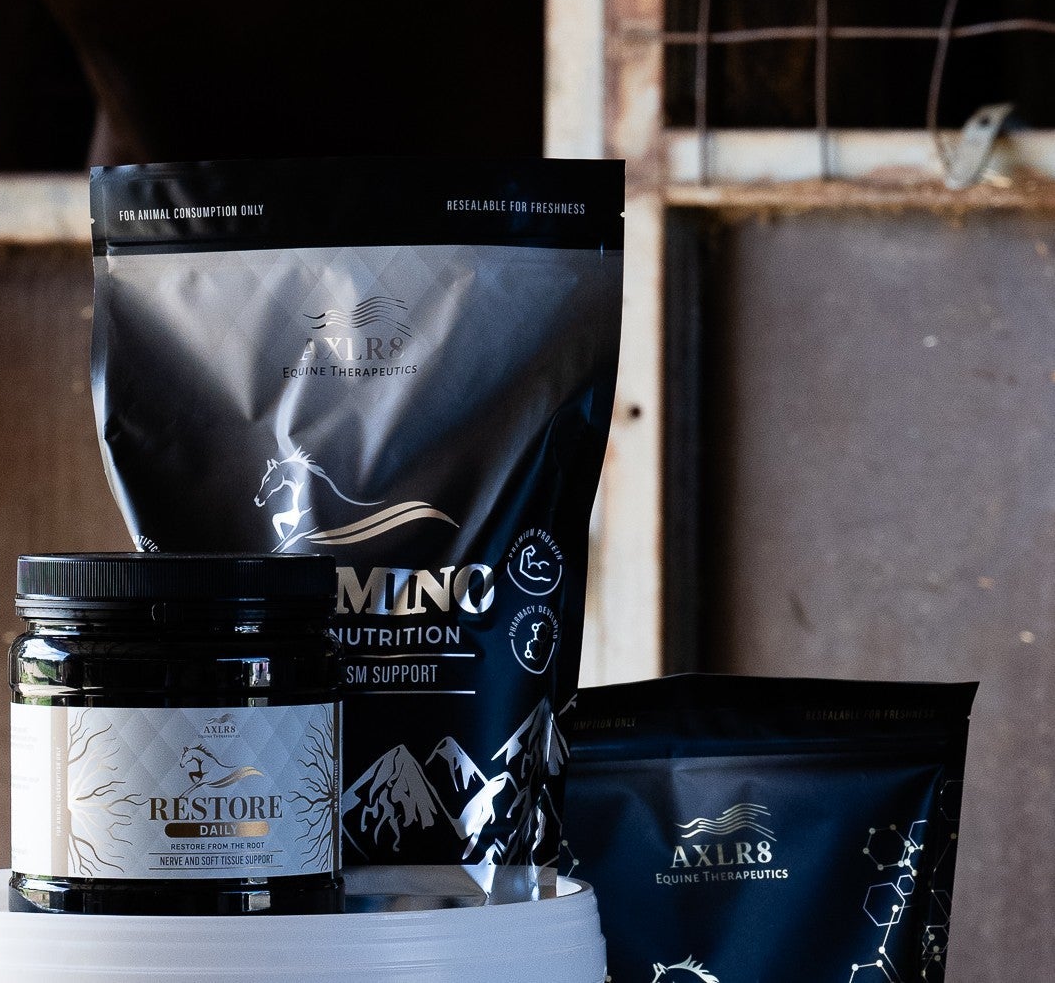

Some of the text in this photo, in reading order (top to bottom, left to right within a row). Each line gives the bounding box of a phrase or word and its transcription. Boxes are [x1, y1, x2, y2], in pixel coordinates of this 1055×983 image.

[119, 204, 264, 221] FOR ANIMAL CONSUMPTION ONLY
[447, 200, 585, 214] RESEALABLE FOR FRESHNESS
[300, 337, 405, 361] AXLR8
[282, 365, 418, 378] EQUINE THERAPEUTICS
[508, 528, 563, 560] PREMIUM PROTEIN
[335, 563, 495, 615] MINO
[508, 605, 559, 639] PHARMACY DEVELOPED
[329, 625, 460, 646] NUTRITION
[346, 664, 438, 684] SM SUPPORT
[203, 725, 236, 734] AXLR8
[572, 717, 637, 730] UMPTION ONLY
[148, 795, 283, 821] RESTORE
[199, 824, 238, 836] DAILY
[208, 842, 228, 850] FROM
[247, 841, 265, 849] ROOT
[160, 854, 274, 866] NERVE AND SOFT TISSUE SUPPORT
[670, 841, 772, 868] AXLR8
[656, 869, 789, 885] EQUINE THERAPEUTICS
